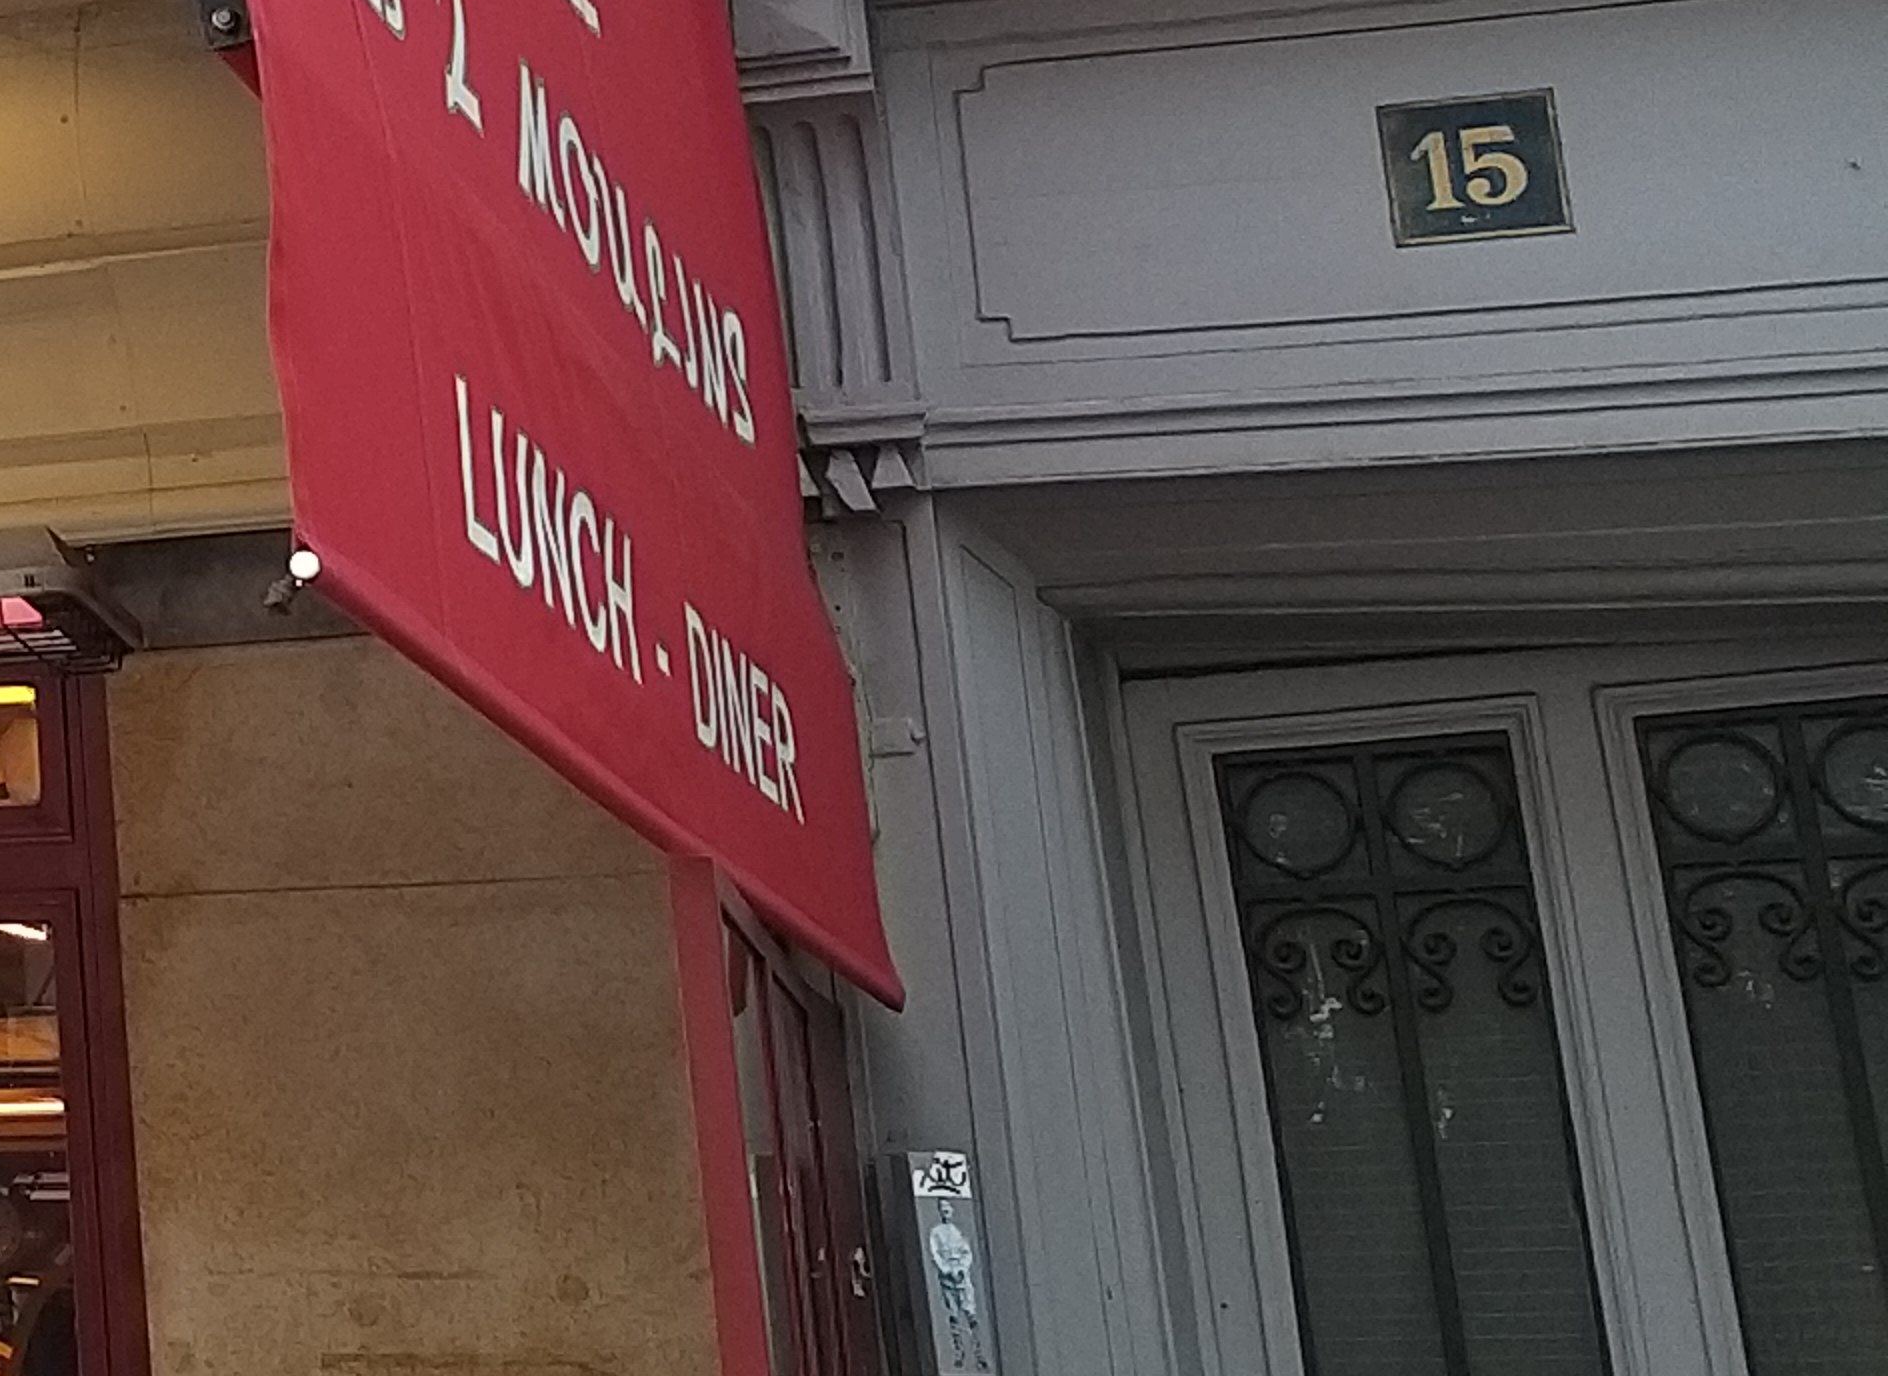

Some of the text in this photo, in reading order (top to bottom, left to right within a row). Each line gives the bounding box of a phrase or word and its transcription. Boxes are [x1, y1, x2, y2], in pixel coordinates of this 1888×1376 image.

[517, 56, 756, 449] MOULINS
[1410, 125, 1528, 211] 15
[454, 372, 644, 686] LUNCH
[683, 601, 806, 826] DINER
